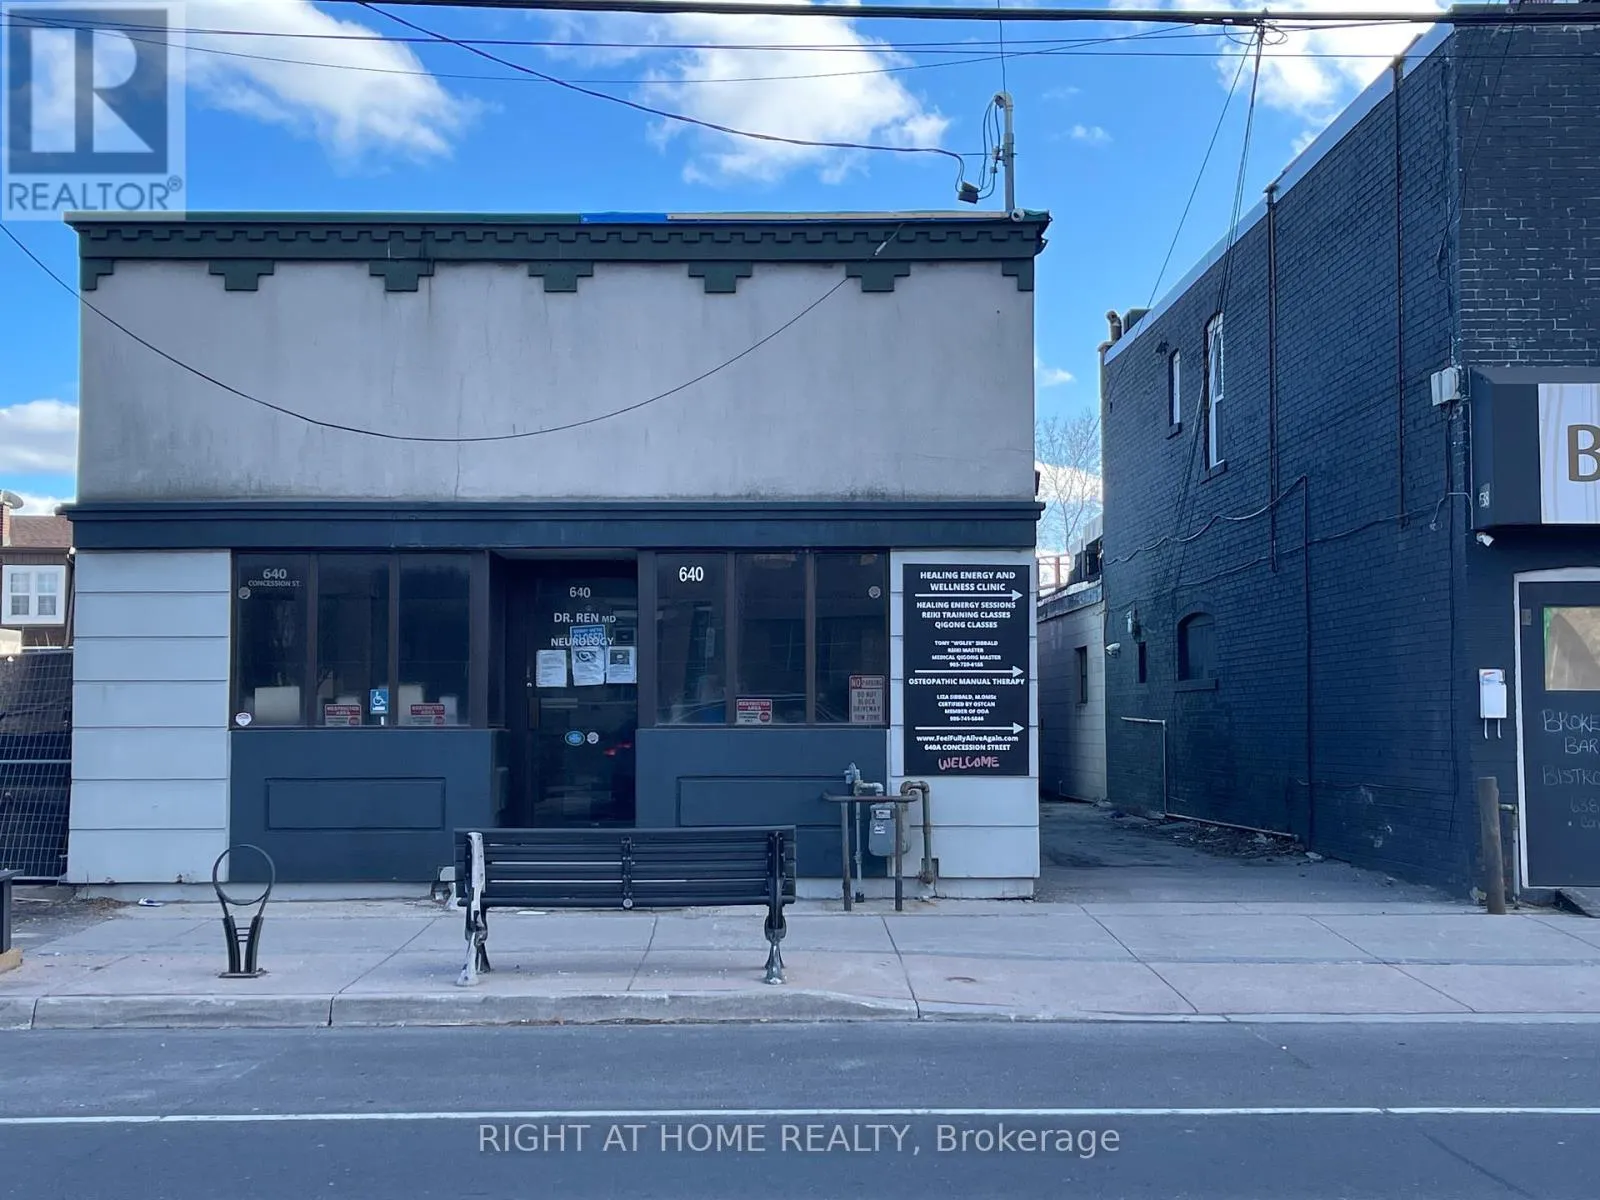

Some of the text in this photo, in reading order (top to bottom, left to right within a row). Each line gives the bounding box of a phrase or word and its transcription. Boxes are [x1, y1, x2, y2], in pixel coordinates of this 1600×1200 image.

[1567, 424, 1600, 483] B
[263, 568, 287, 579] 640
[679, 566, 704, 582] 640
[570, 586, 590, 598] 640
[554, 612, 574, 622] DR.
[576, 612, 599, 622] REN
[935, 622, 966, 630] QIGONG
[550, 637, 614, 646] NEUROLOGY
[852, 678, 860, 688] NO
[1564, 736, 1598, 754] BAR
[938, 756, 999, 770] WELCOME
